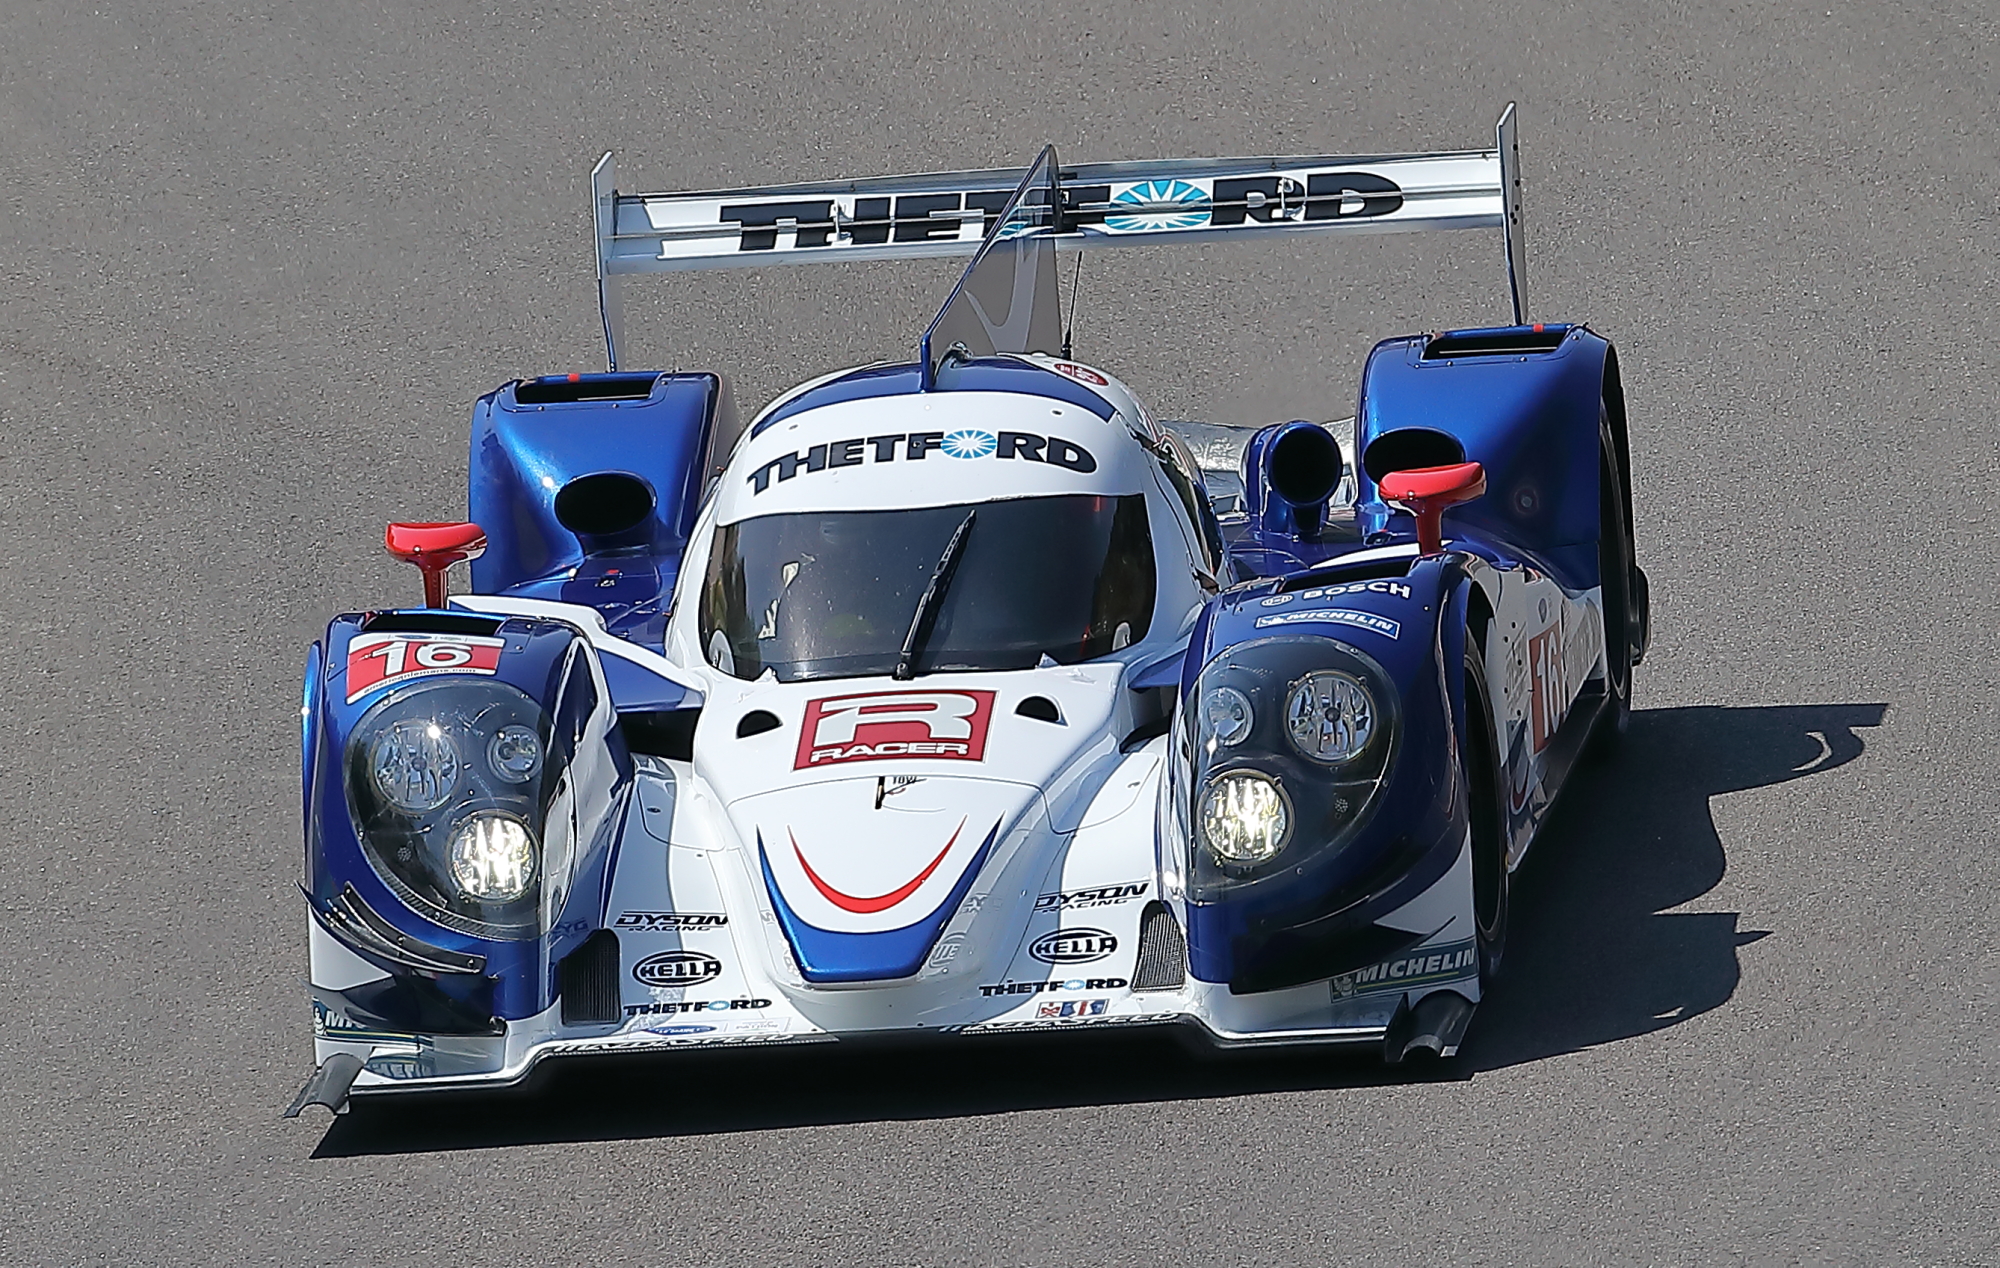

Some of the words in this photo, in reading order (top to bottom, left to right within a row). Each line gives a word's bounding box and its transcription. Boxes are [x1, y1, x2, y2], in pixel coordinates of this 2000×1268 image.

[746, 430, 1099, 497] THETFORD
[1303, 582, 1410, 599] BOSCH
[1286, 610, 1394, 631] MICHELIN
[370, 641, 473, 676] 16
[1536, 631, 1560, 739] 16
[809, 742, 968, 765] RACER
[1035, 882, 1149, 908] DYSON
[1041, 899, 1128, 913] RACING
[615, 913, 729, 926] DYSON
[1035, 936, 1118, 954] HELLA
[640, 960, 722, 978] HELLA
[1356, 947, 1475, 983] MICHELIN
[979, 978, 1128, 997] THETFORD
[623, 998, 773, 1016] THETFORD
